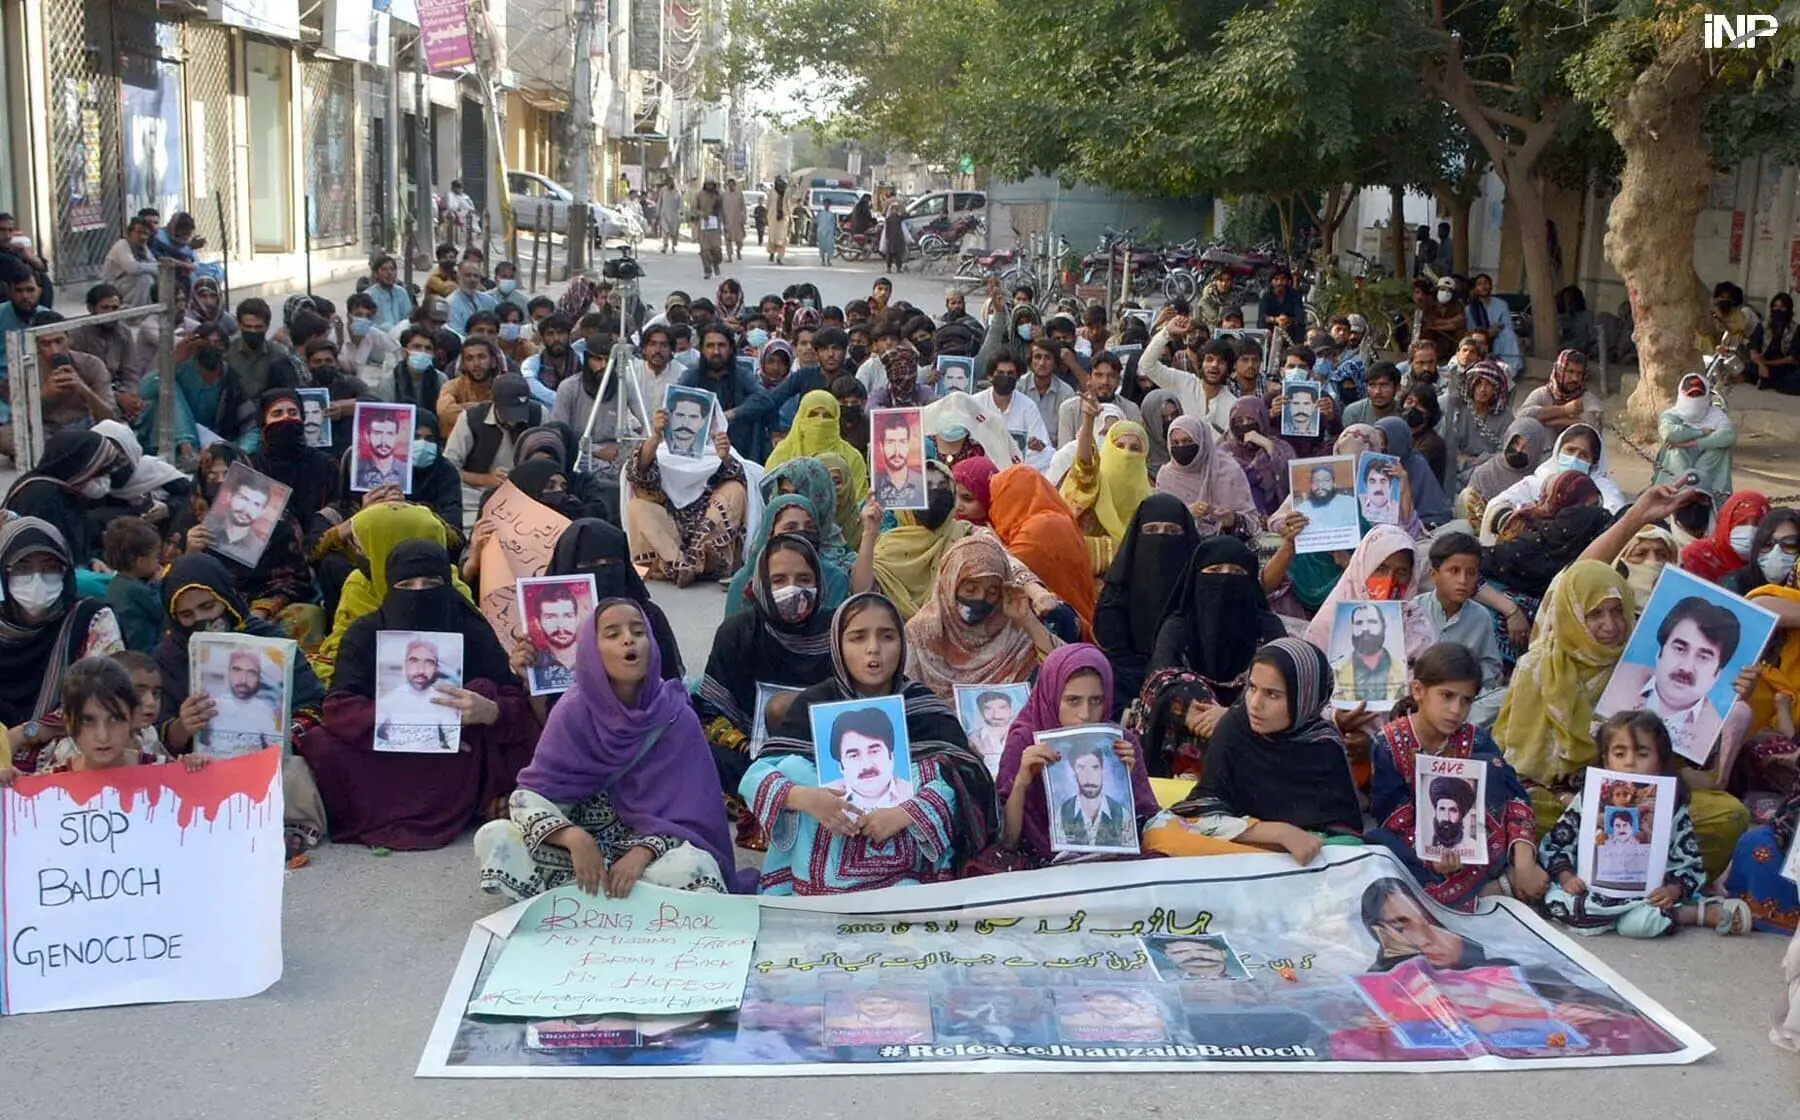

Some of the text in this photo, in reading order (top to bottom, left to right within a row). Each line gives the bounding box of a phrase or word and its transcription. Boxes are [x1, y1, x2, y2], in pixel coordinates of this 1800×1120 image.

[1431, 760, 1465, 775] SAVE
[59, 809, 129, 853] STOP
[38, 868, 161, 906] BALOCH
[535, 895, 722, 932] BRING BACK
[13, 926, 183, 976] GENOCIDE
[665, 953, 734, 972] BACK
[879, 1043, 1316, 1059] #ReleaseJhanzaibBaloch
